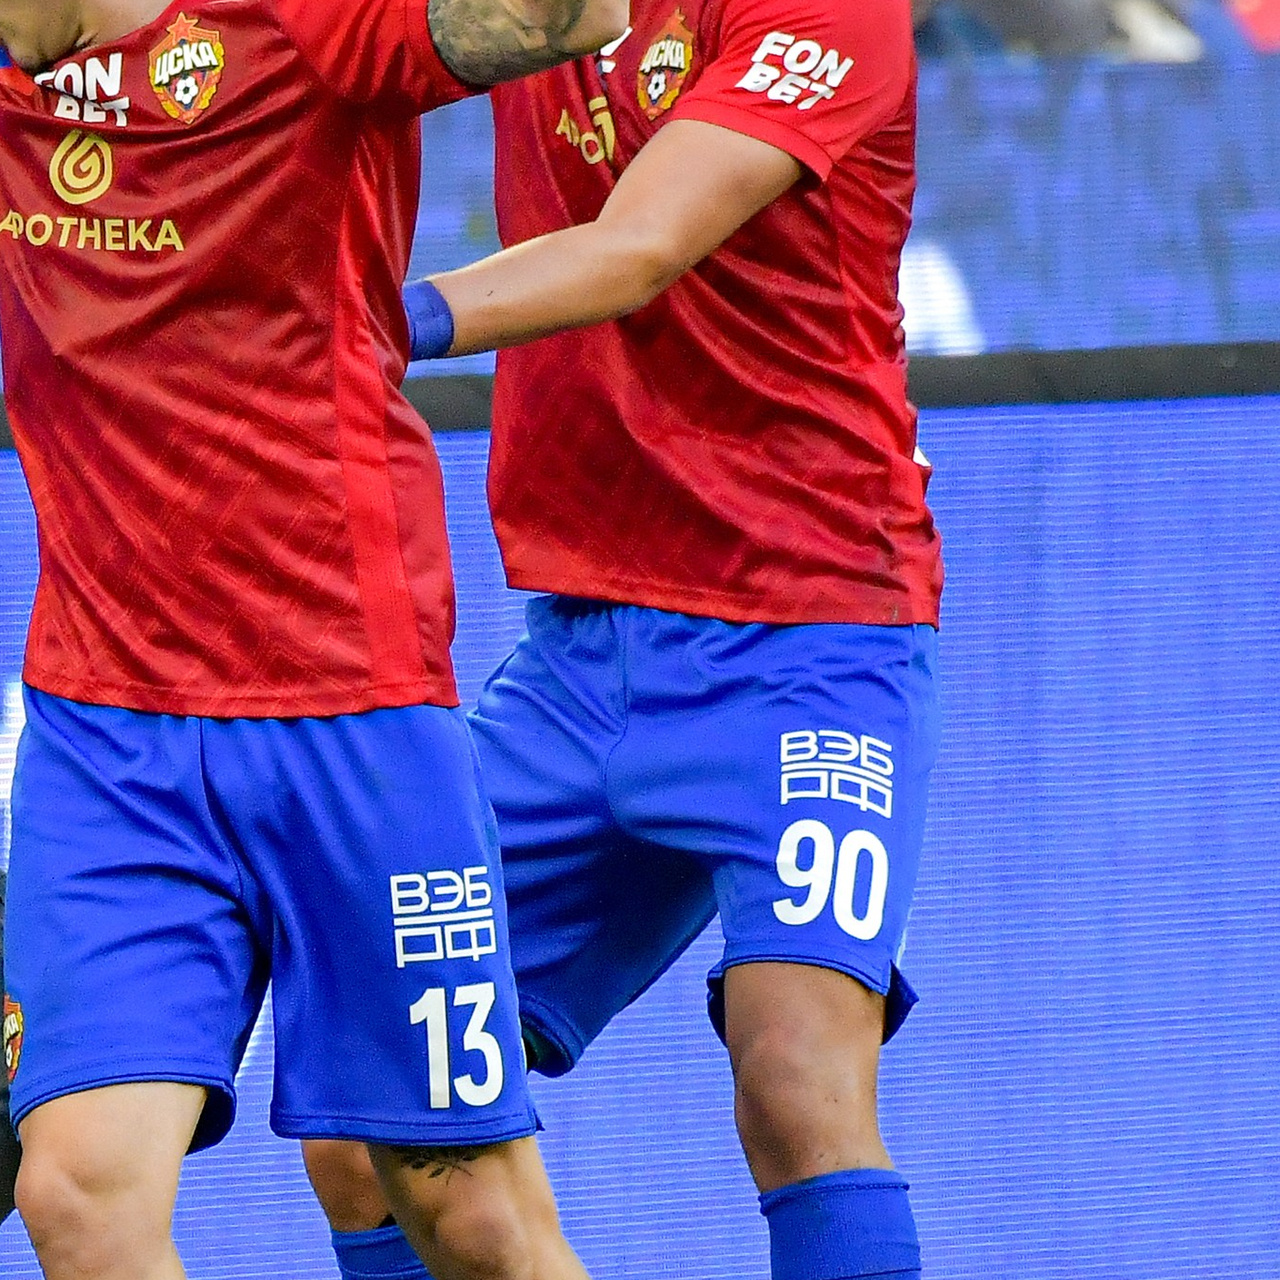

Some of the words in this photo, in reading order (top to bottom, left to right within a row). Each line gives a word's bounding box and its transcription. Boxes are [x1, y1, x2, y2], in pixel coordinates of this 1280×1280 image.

[154, 41, 219, 86] ЦСКА
[751, 30, 855, 88] FON
[734, 62, 836, 111] BET
[780, 729, 894, 776] ВЭБ
[390, 866, 492, 915] ВЭБ
[773, 819, 889, 942] 90
[409, 982, 504, 1110] 13
